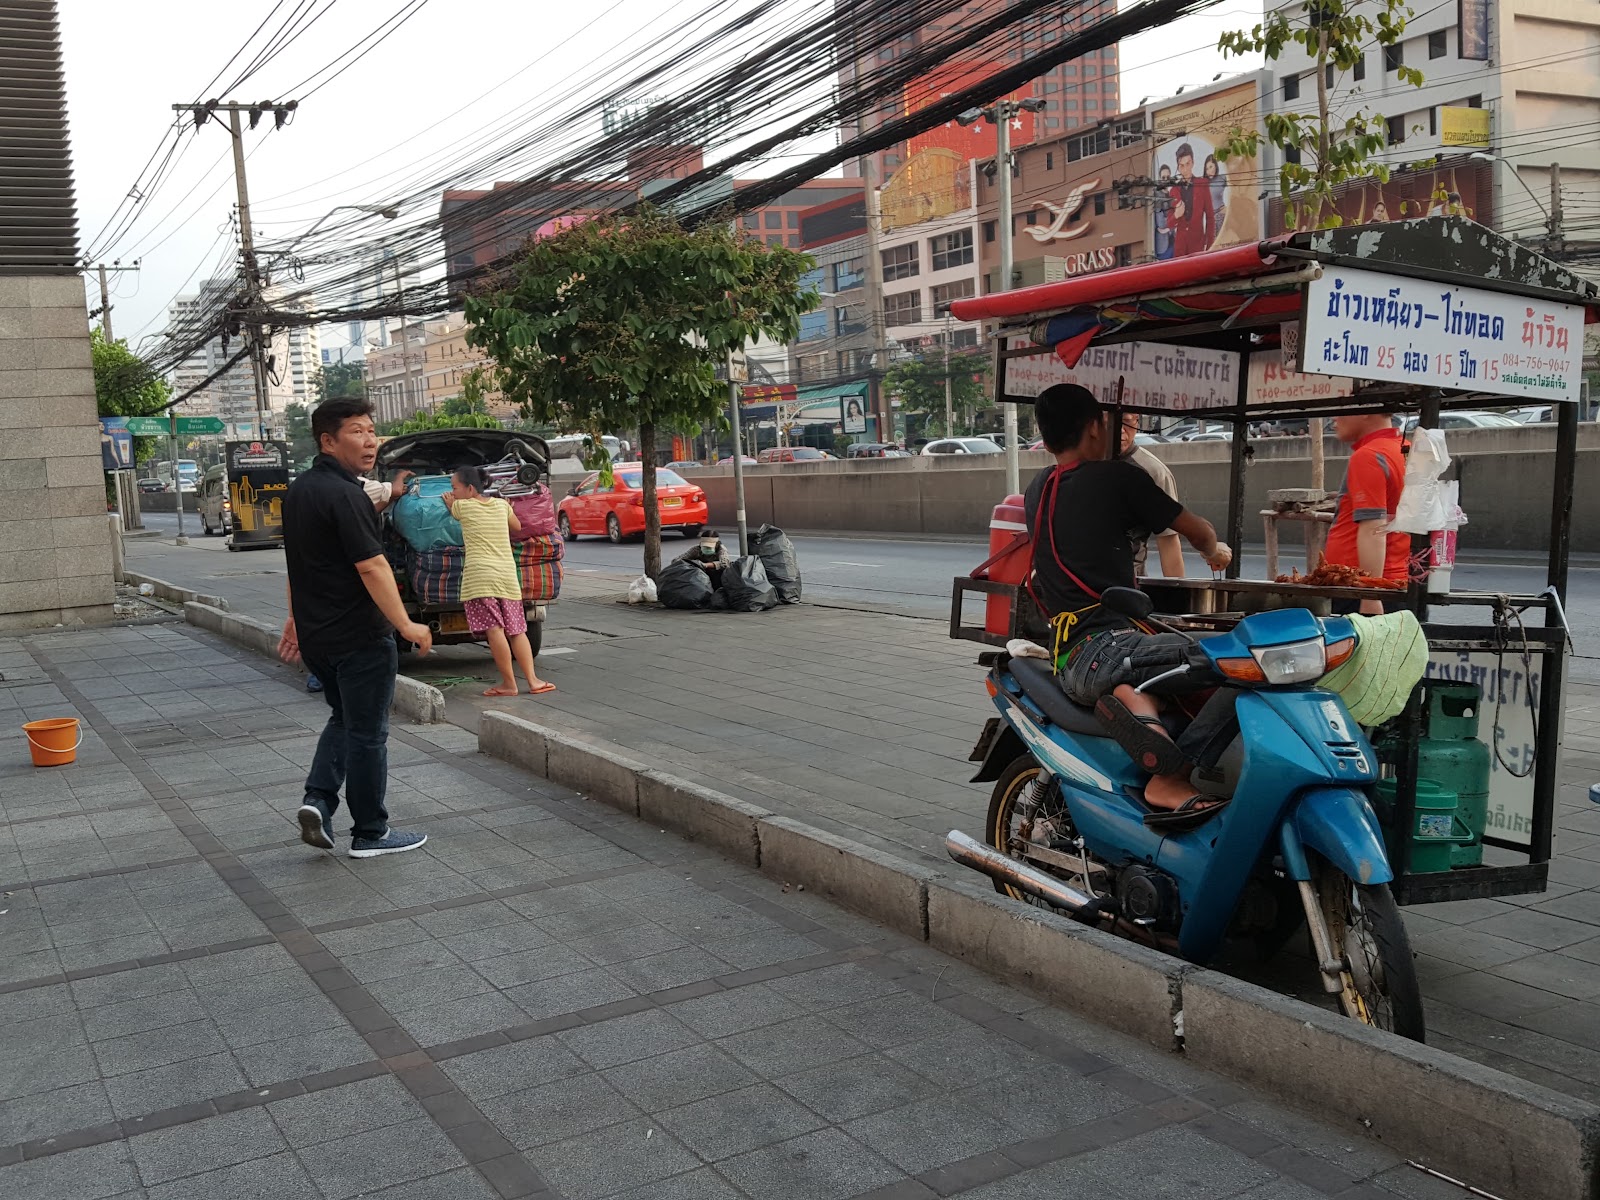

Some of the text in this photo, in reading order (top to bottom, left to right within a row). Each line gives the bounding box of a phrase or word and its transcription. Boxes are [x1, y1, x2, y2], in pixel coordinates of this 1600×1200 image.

[1065, 247, 1114, 275] GRASS
[1327, 279, 1504, 341] ข้าวเหนียว-ไก่ทอด
[1323, 330, 1499, 381] สะโพก 25 น่อง 15 ปีก 15
[1502, 352, 1571, 373] 084-756-9647
